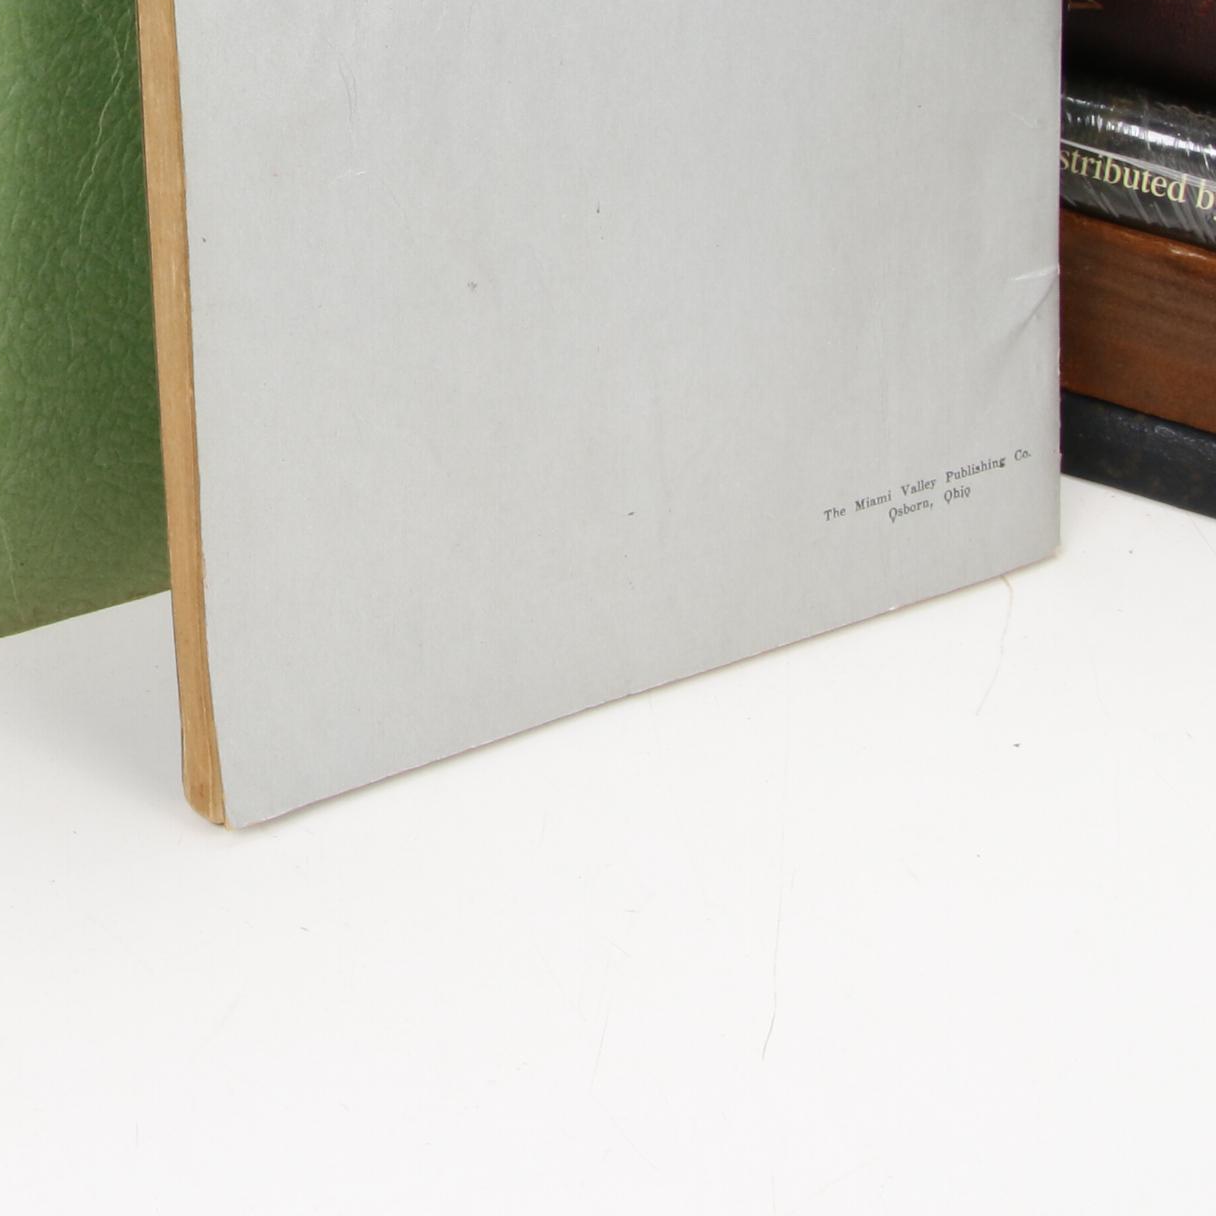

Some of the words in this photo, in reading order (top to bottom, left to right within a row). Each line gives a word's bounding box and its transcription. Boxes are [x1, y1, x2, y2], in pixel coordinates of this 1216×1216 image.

[824, 506, 846, 522] The
[854, 490, 892, 512] Miami
[900, 478, 937, 497] Valley
[944, 457, 1006, 484] Publishing
[1014, 449, 1032, 462] Co.
